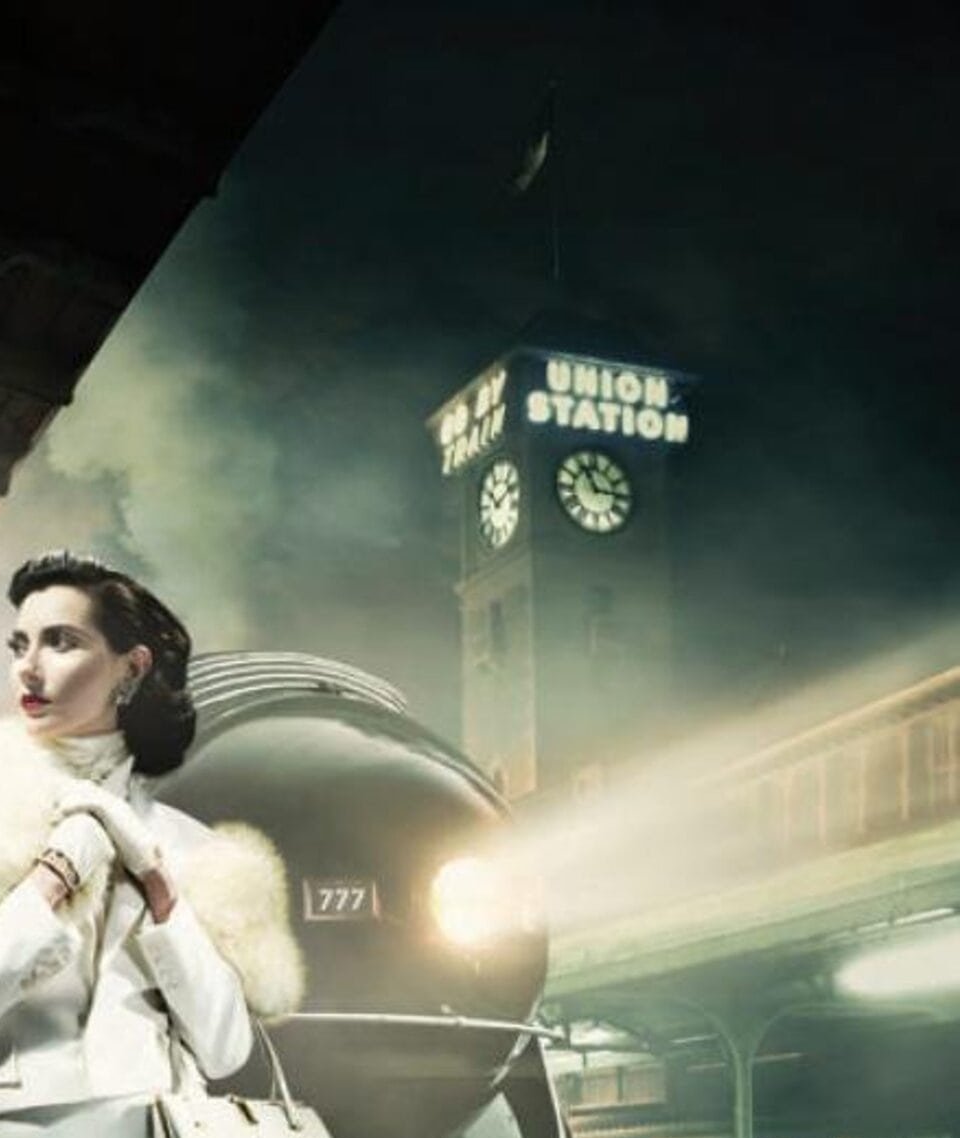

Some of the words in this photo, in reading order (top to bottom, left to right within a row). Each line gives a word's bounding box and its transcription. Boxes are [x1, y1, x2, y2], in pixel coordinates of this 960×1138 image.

[546, 359, 668, 408] UNION
[527, 390, 689, 443] STATION
[319, 887, 366, 911] 777
